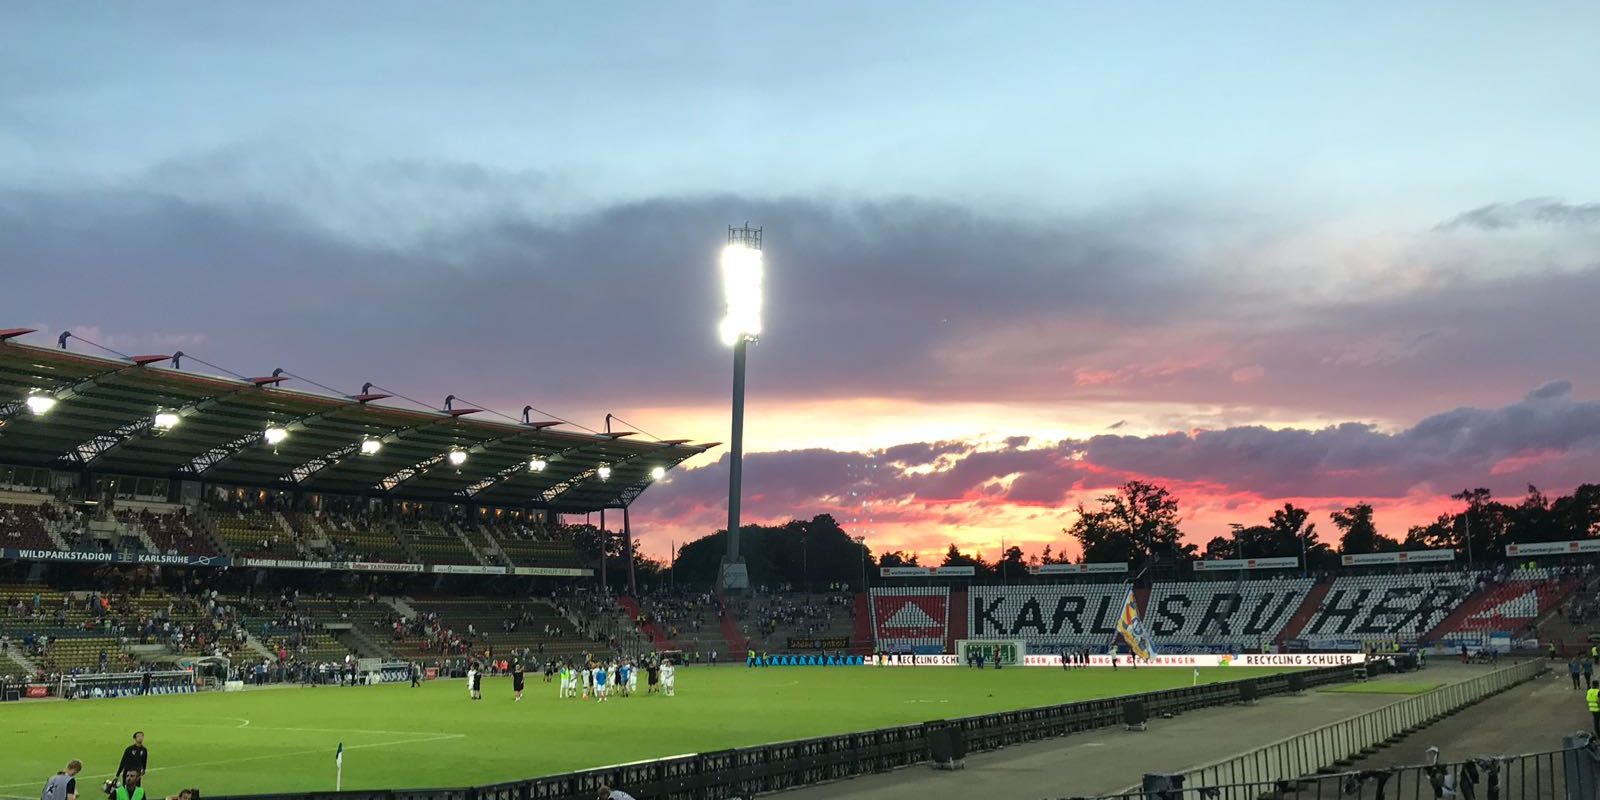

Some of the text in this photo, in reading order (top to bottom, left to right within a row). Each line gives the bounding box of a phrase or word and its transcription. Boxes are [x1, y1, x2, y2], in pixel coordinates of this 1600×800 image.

[19, 549, 112, 561] WILDPARKSTADION
[138, 554, 189, 564] KARLSRUHE
[1246, 655, 1302, 665] RECYCLING
